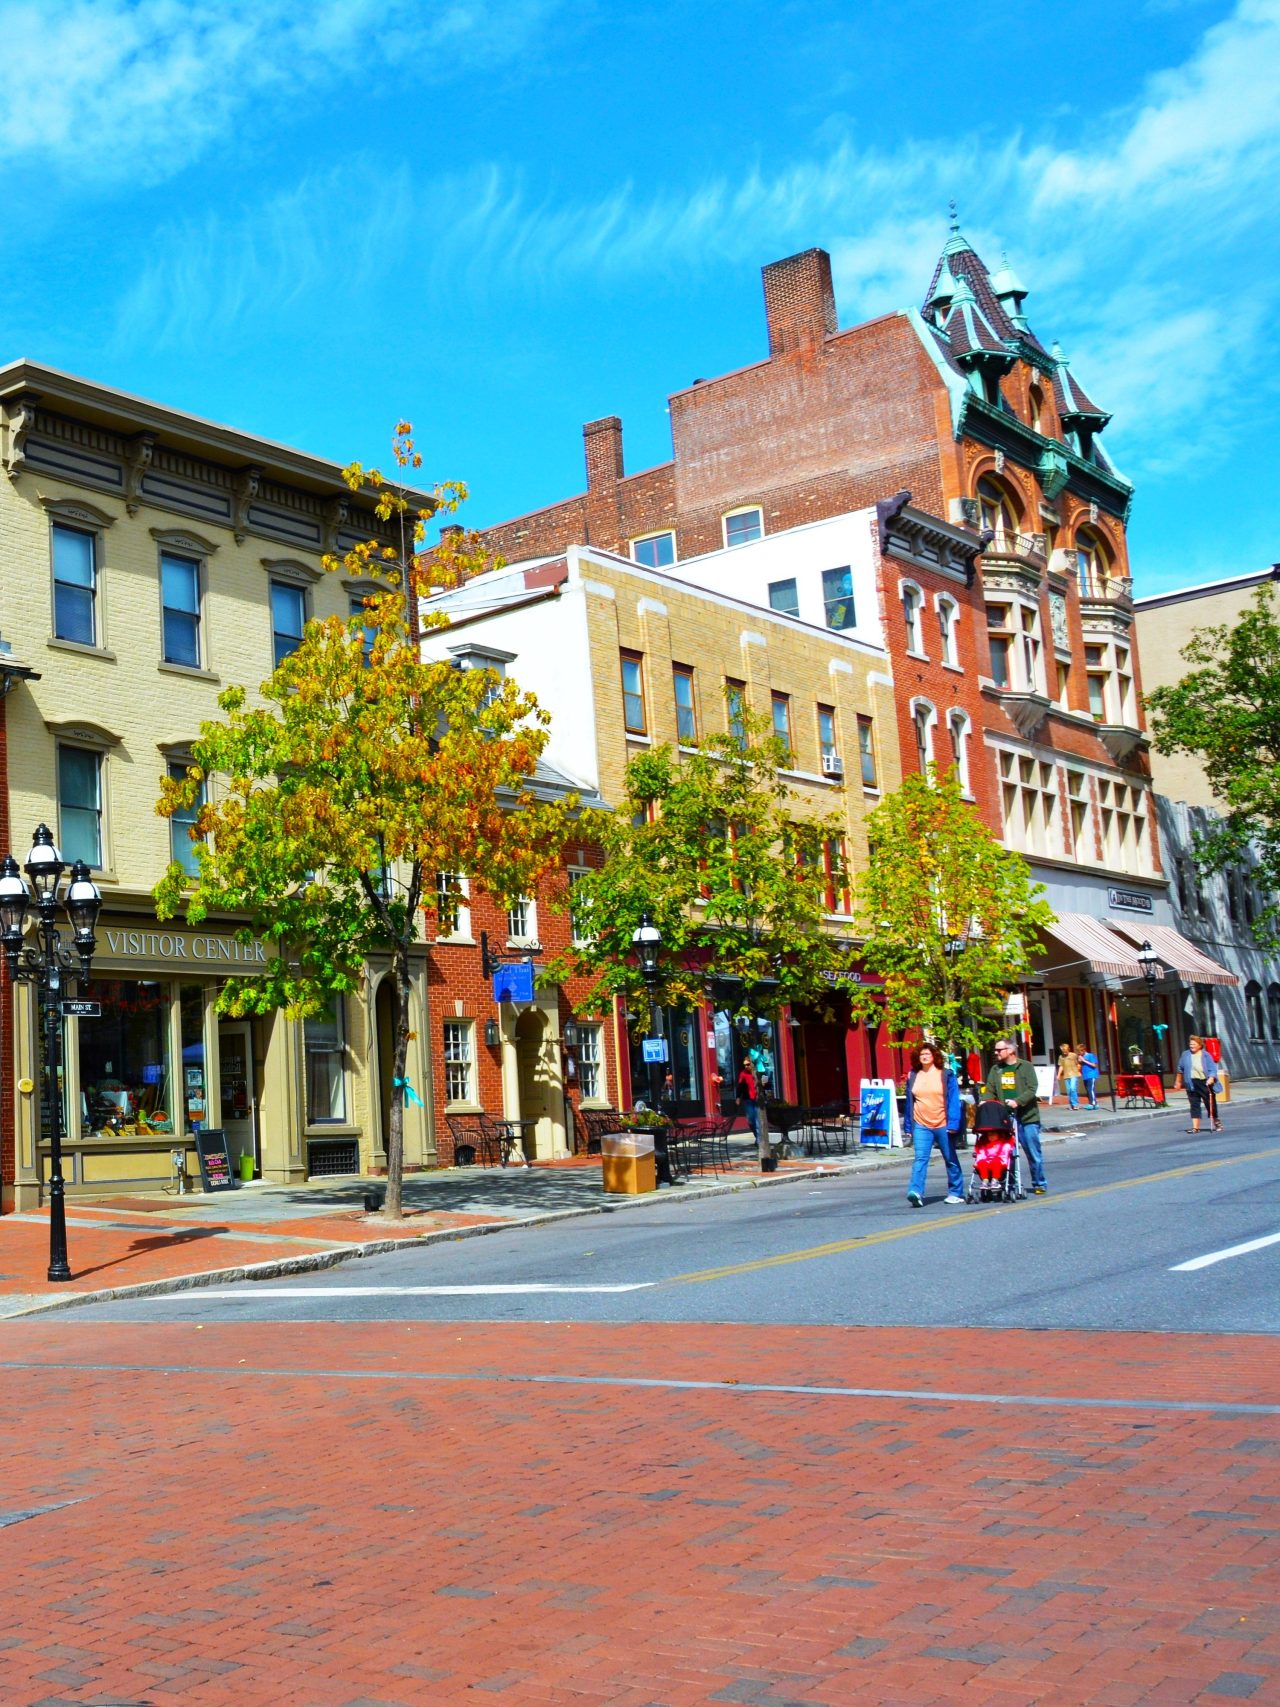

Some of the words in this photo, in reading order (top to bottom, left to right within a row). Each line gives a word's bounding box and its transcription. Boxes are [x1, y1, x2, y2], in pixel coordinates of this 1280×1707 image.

[106, 931, 187, 958] VISITOR
[192, 937, 267, 962] CENTER
[822, 970, 861, 982] SEAFOOD
[70, 1003, 84, 1011] MAIN
